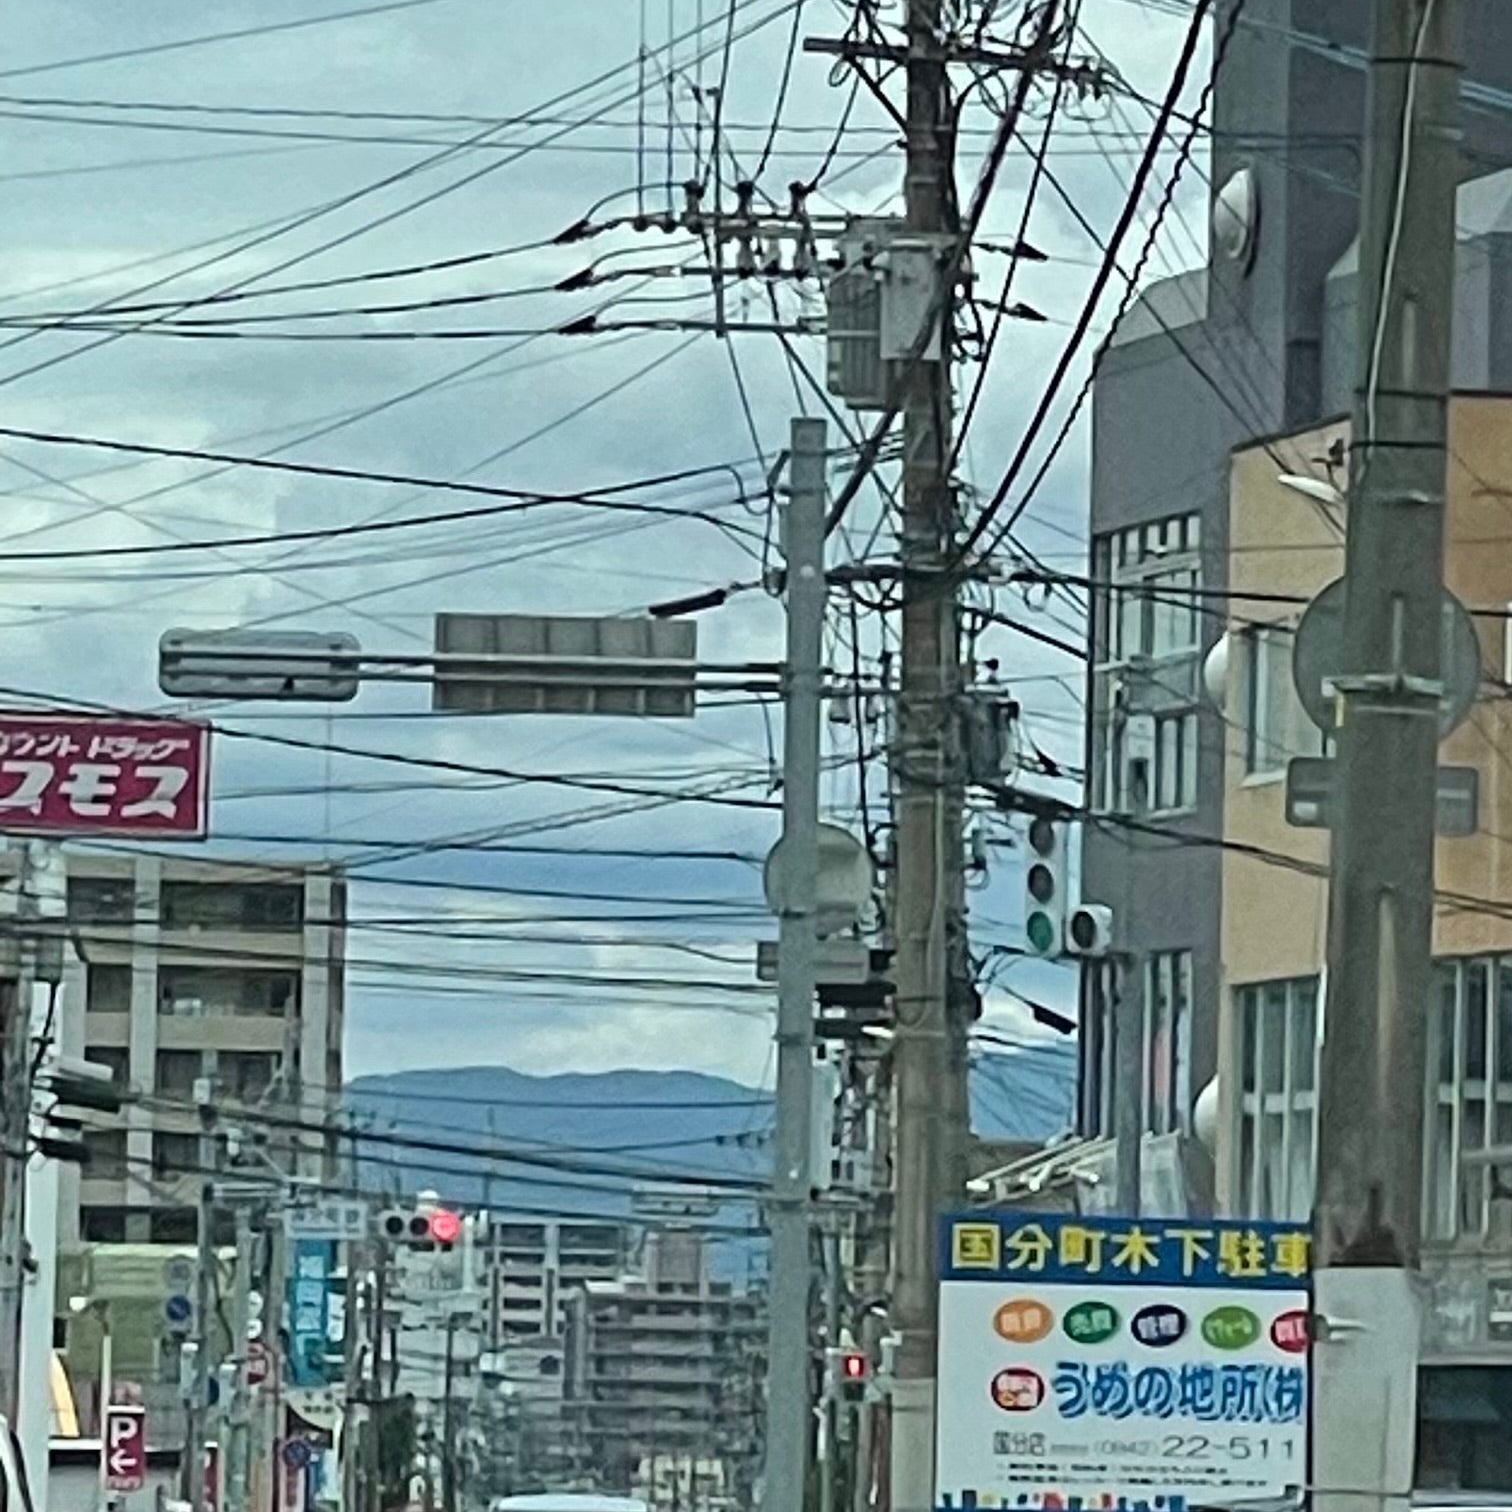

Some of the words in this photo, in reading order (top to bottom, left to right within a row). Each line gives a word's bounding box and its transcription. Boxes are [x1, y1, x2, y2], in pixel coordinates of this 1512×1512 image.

[951, 1221, 1312, 1279] 国分町木下駐車
[110, 1416, 138, 1448] P
